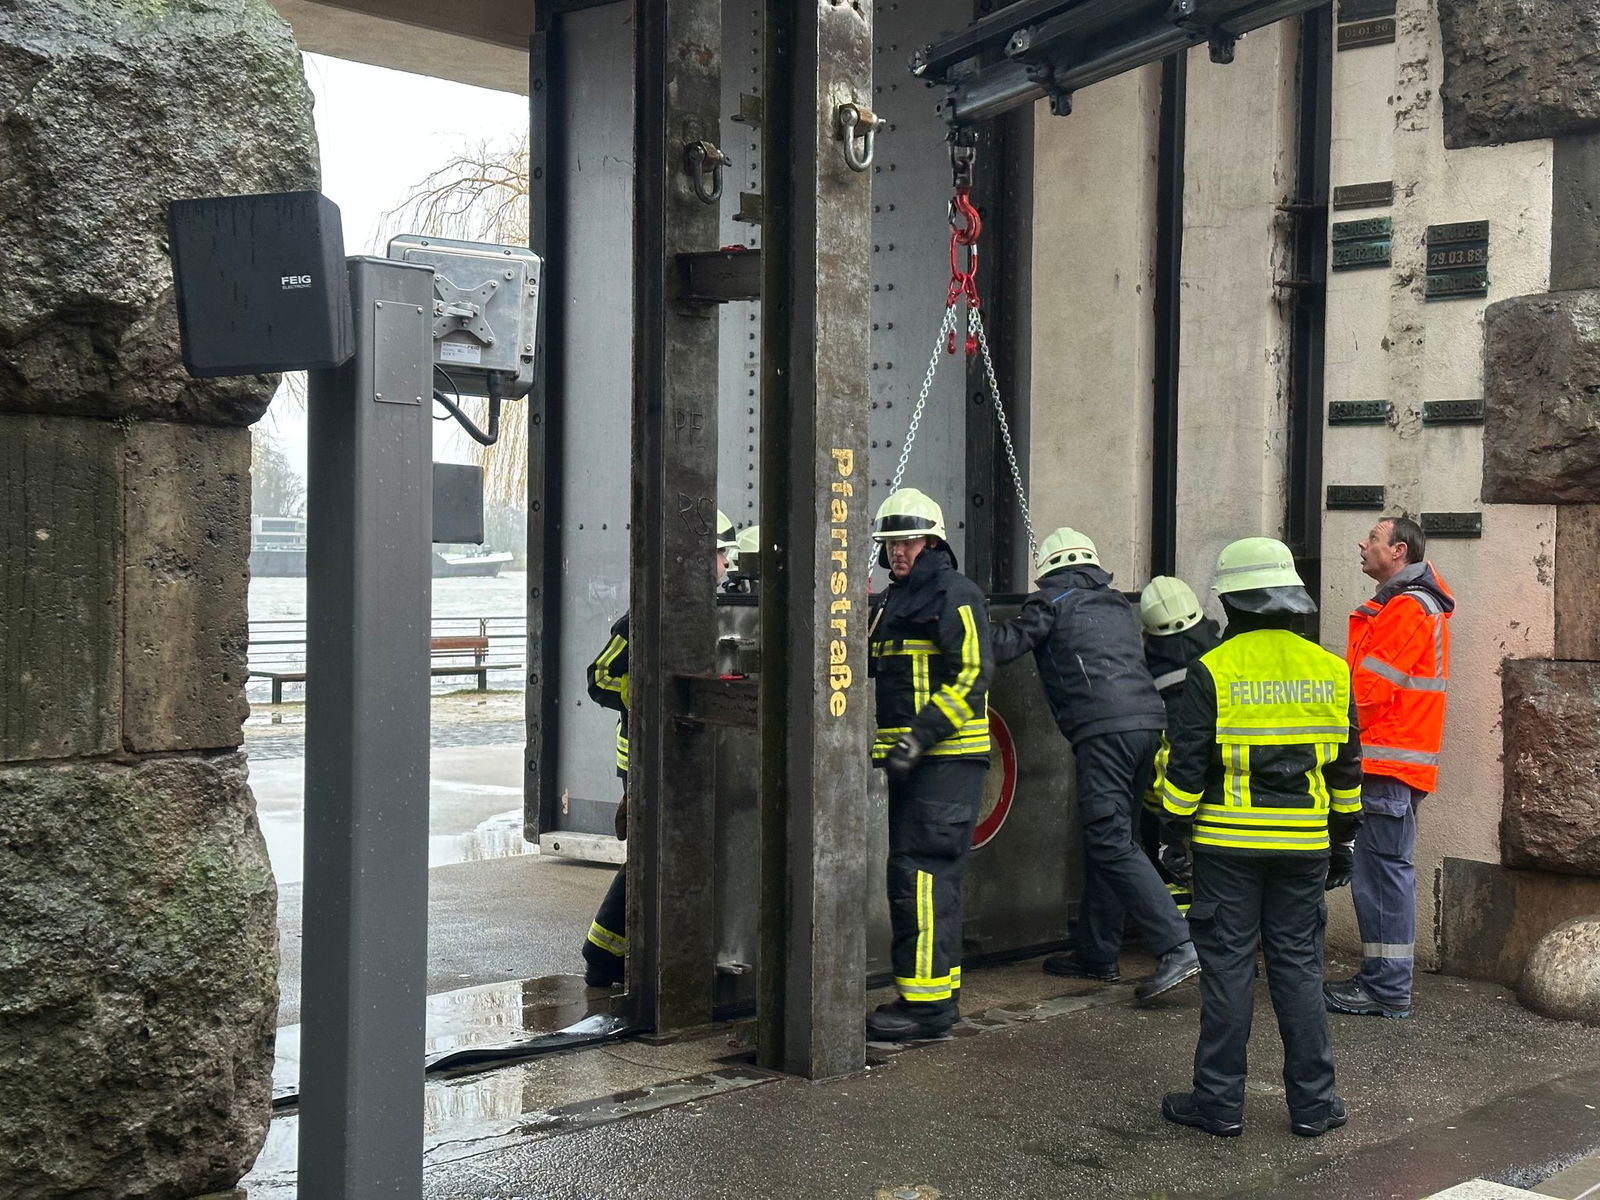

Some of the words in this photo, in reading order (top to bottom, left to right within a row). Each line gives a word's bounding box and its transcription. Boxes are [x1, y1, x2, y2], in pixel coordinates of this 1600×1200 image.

[1431, 248, 1483, 265] 29.03.88
[281, 275, 312, 285] FEIG
[830, 448, 853, 717] Pfarrstraße
[1230, 680, 1335, 705] FEUERWEHR
